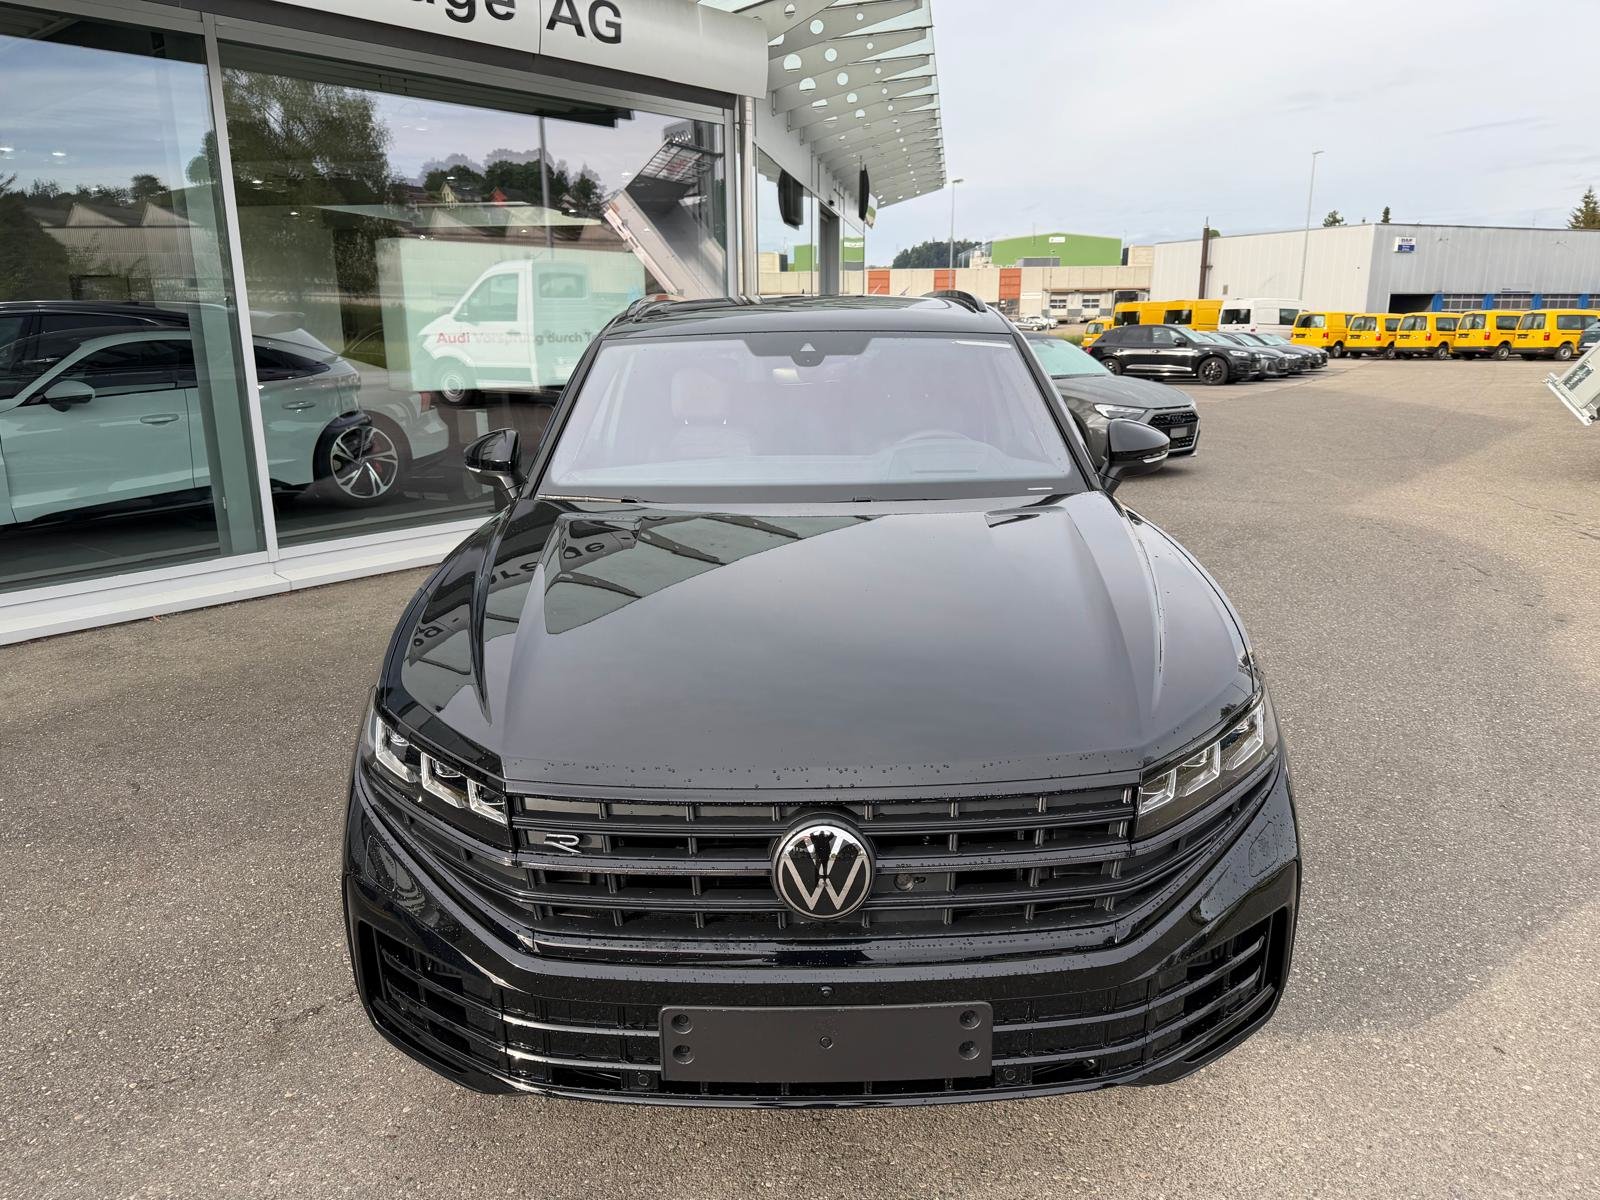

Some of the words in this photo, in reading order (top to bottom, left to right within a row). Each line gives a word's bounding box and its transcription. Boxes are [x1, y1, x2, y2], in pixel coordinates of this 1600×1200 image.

[546, 0, 622, 44] AG
[436, 332, 471, 344] Audi
[547, 331, 583, 344] durch
[778, 825, 871, 912] VW
